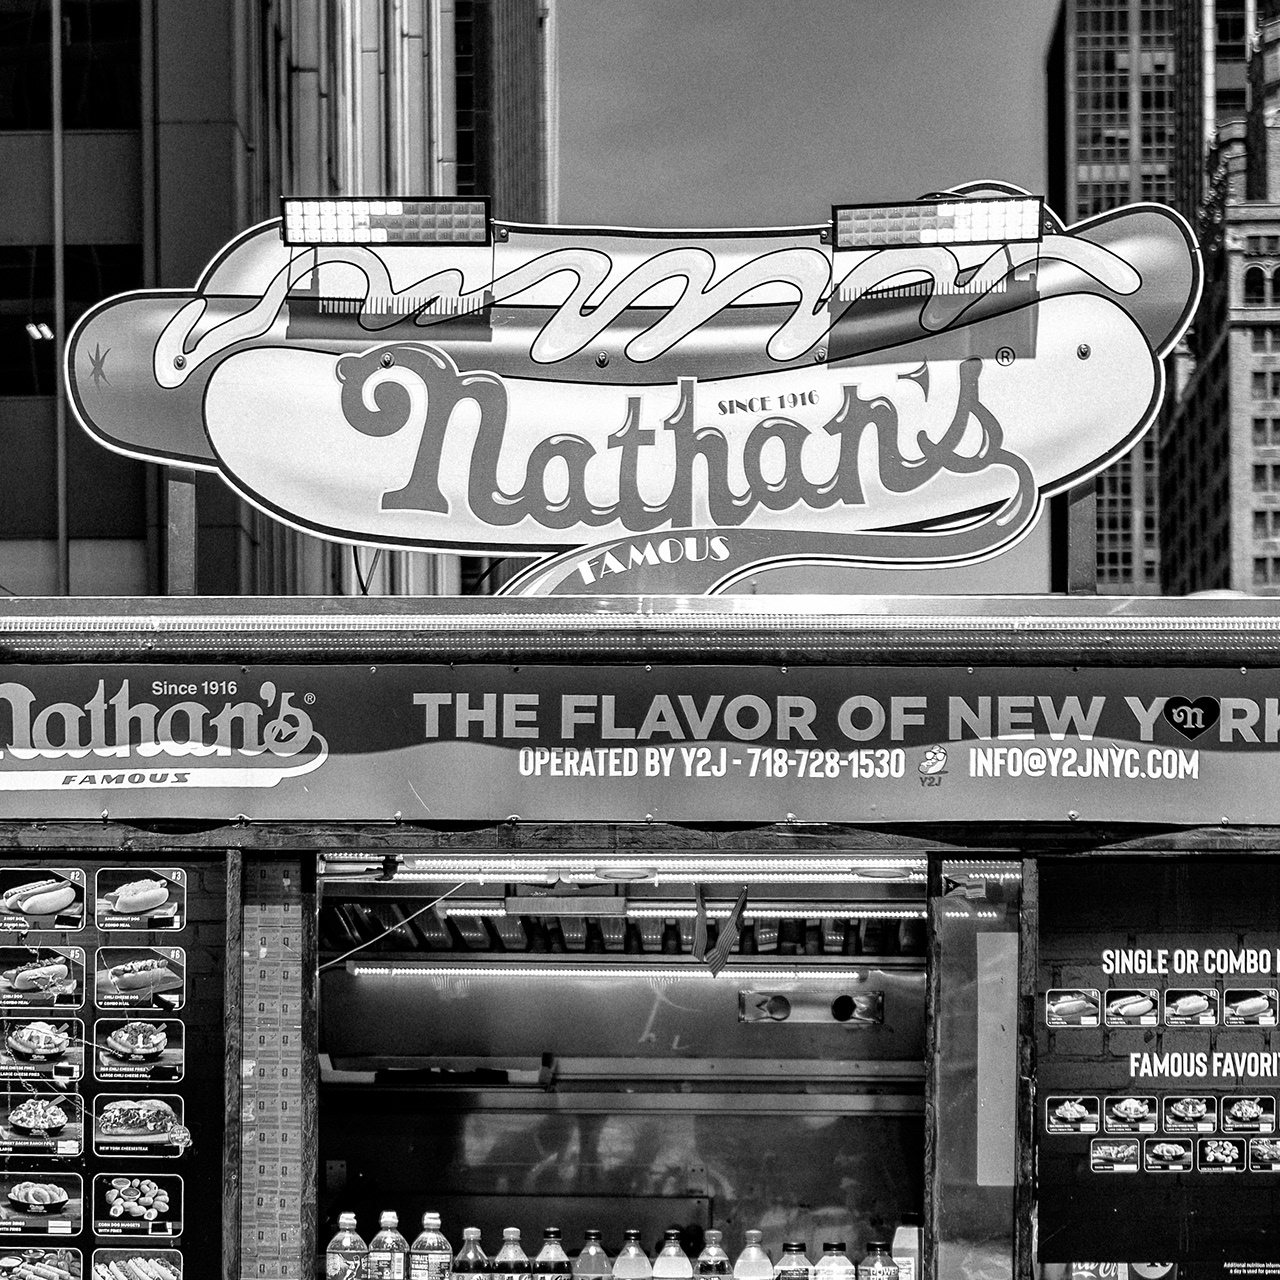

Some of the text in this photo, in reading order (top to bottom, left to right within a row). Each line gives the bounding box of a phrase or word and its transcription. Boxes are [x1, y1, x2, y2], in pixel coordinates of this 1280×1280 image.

[718, 390, 820, 417] SINCE 1916
[336, 348, 1012, 529] Nathan's
[576, 535, 730, 586] FAMOUS
[152, 681, 238, 696] Since 1916
[413, 692, 539, 738] THE
[561, 693, 818, 741] FLAVOR
[836, 695, 927, 742] OF
[949, 695, 1107, 742] NEW
[519, 747, 906, 779] OPERATED BY Y2J 718-728-1530
[968, 748, 1200, 780] INFO@Y2JNYC.COM
[63, 772, 191, 786] FAMOUS
[919, 777, 943, 788] Y2J
[70, 870, 80, 881] #2
[171, 870, 181, 881] #3
[70, 949, 80, 959] #5
[170, 949, 181, 959] #6
[1102, 949, 1169, 974] SINGLE
[1173, 949, 1199, 974] OR
[1204, 949, 1271, 974] COMBO
[1130, 1052, 1208, 1077] FAMOUS
